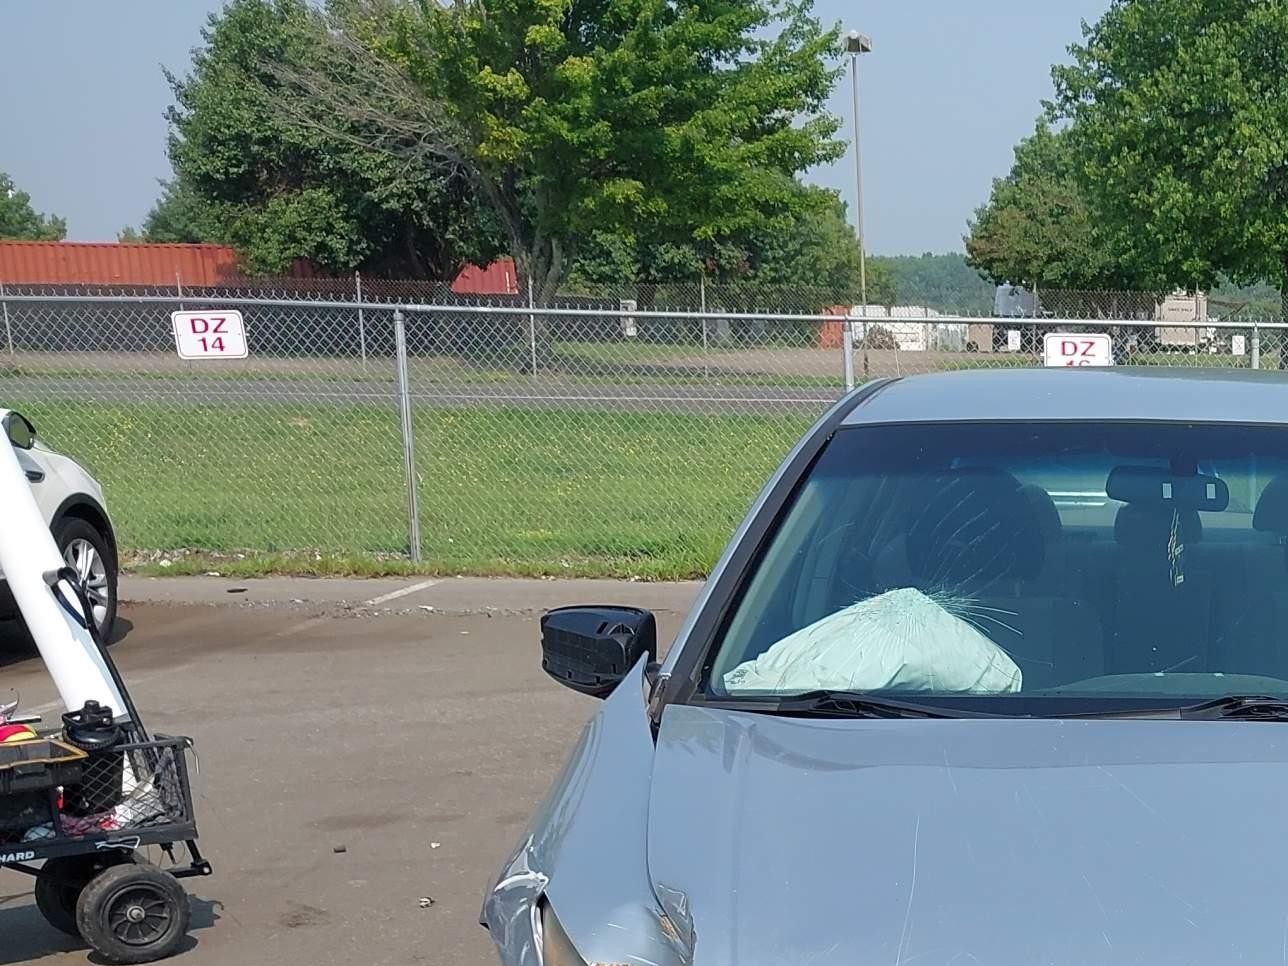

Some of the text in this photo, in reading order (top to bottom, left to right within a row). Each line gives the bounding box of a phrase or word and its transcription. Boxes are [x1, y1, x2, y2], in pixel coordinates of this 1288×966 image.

[190, 318, 229, 334] DZ
[197, 337, 226, 352] 14
[1061, 341, 1097, 357] DZ
